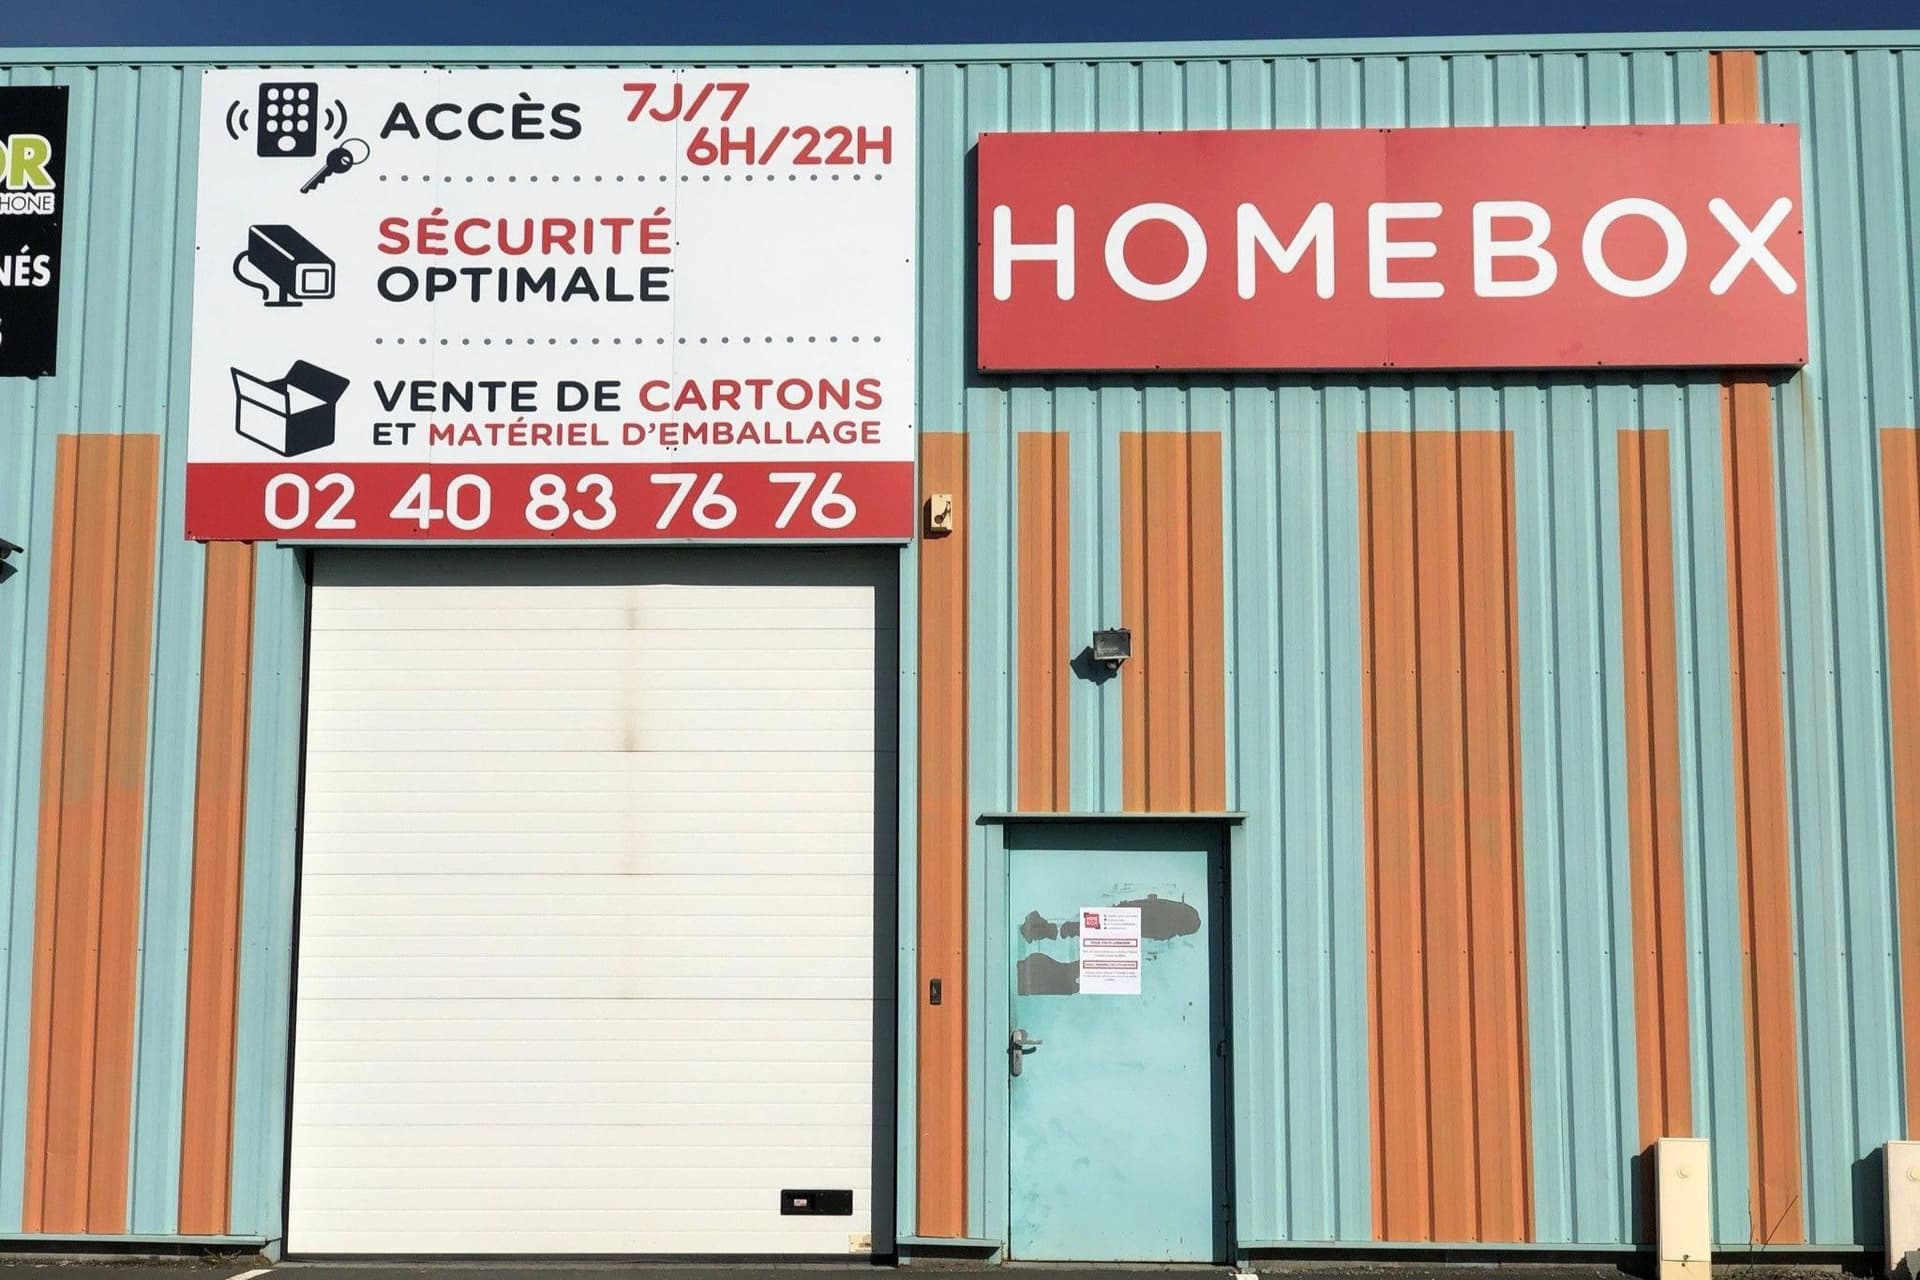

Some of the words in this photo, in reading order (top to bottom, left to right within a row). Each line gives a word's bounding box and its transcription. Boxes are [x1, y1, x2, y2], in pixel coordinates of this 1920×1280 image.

[380, 92, 581, 140] ACCÈS
[623, 83, 749, 122] 7J/7
[0, 134, 56, 190] R
[687, 126, 891, 166] 6H/22H
[378, 207, 671, 255] SÉCURITÉ
[994, 196, 1798, 301] HOMEBOX
[378, 266, 670, 302] OPTIMALE
[374, 380, 537, 412] VENTE
[557, 381, 621, 412] DE
[639, 379, 882, 412] CARTONS
[373, 423, 416, 445] ET
[430, 417, 609, 446] MATÉRIEL
[623, 421, 880, 445] D'EMBALLAGE
[265, 473, 356, 529] 02
[390, 474, 490, 530] 40
[526, 474, 616, 530] 83
[651, 473, 737, 529] 76
[769, 473, 856, 528] 76
